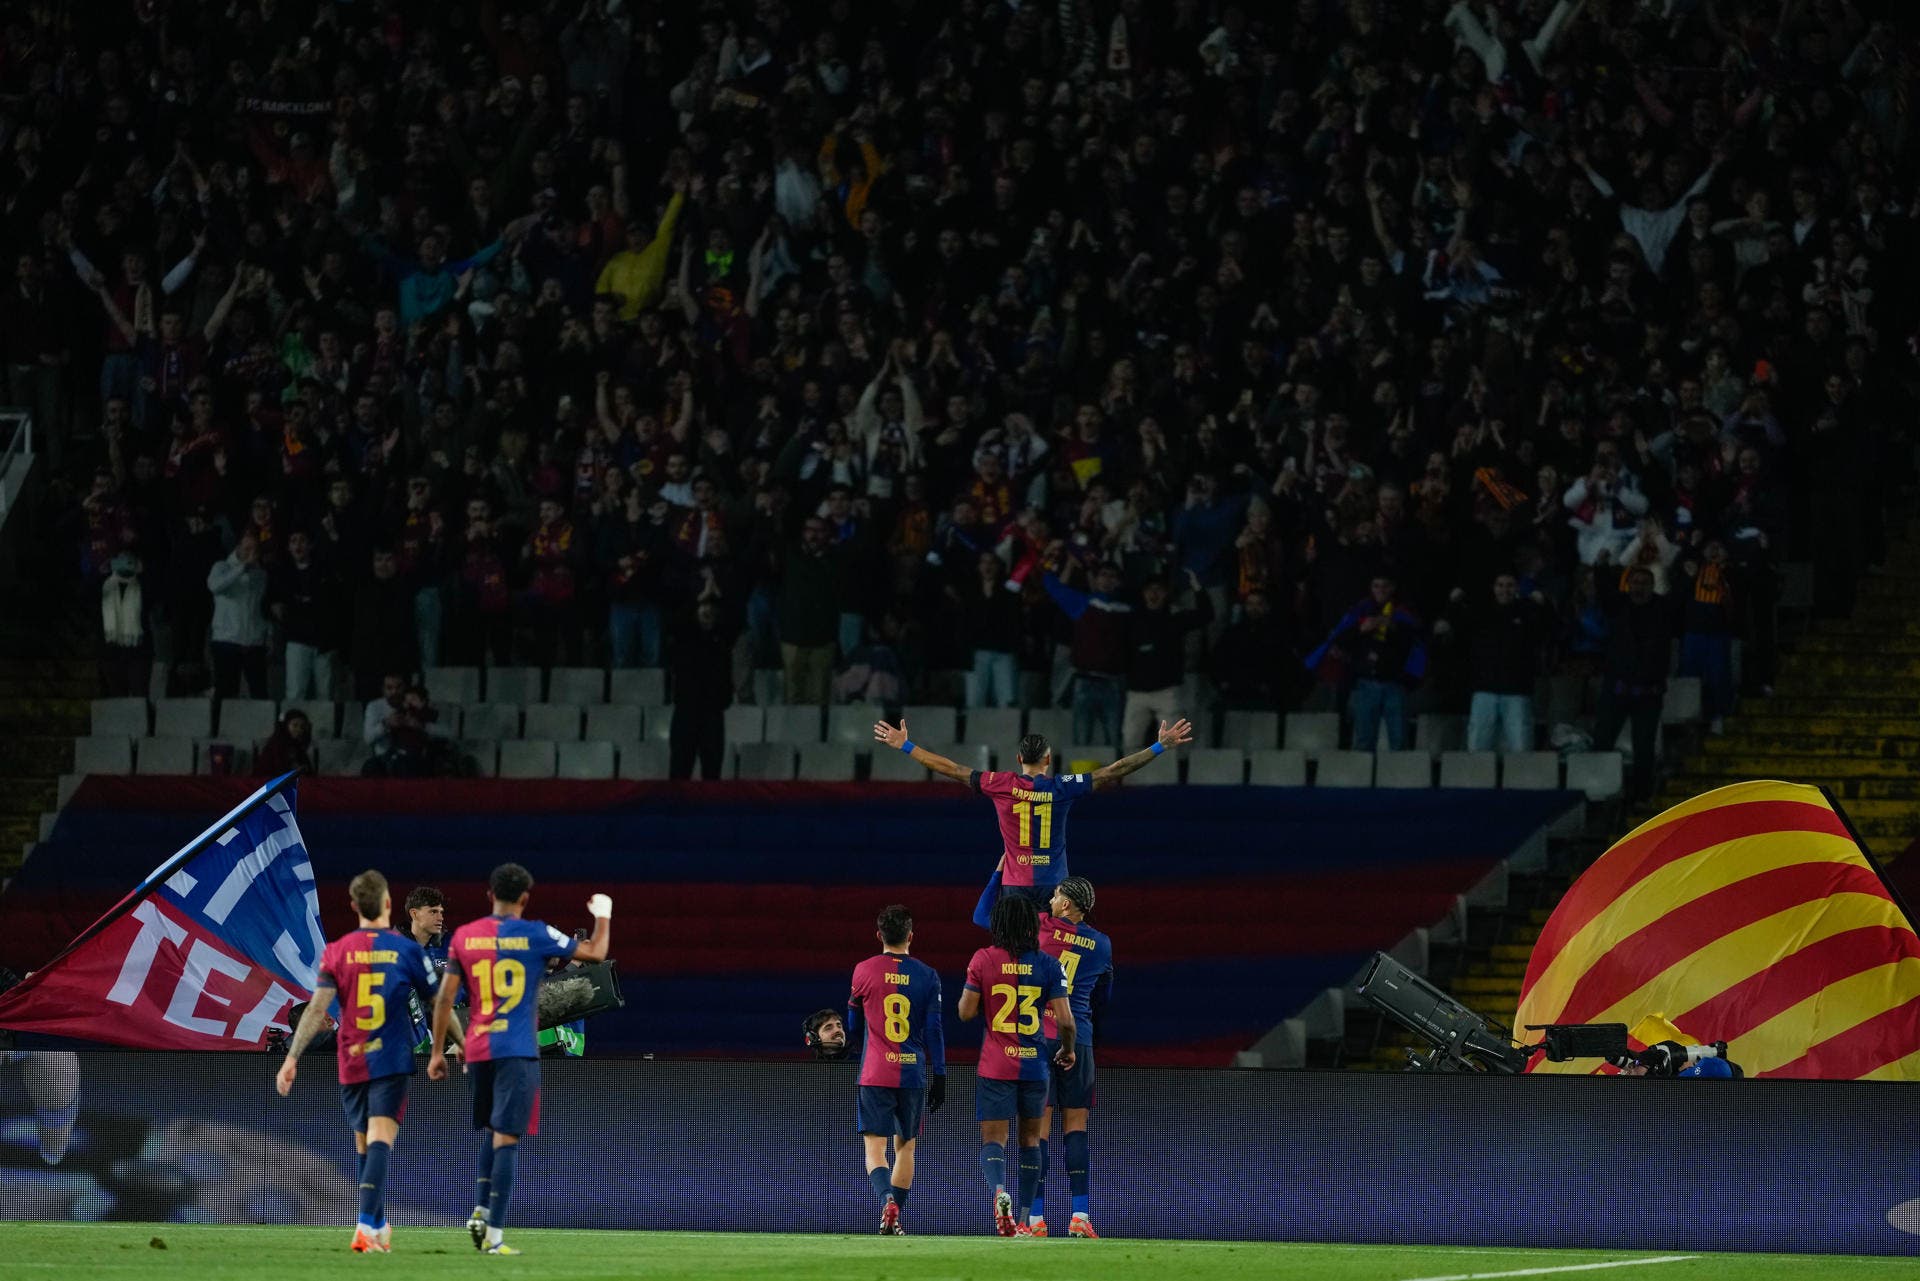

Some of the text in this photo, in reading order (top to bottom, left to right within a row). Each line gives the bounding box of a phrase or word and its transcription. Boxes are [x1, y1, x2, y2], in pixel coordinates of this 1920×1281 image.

[1011, 787, 1053, 802] RAPHINHA
[1012, 801, 1052, 848] 11
[1053, 929, 1096, 950] R. ARAUJO
[355, 972, 386, 1031] 5
[471, 958, 526, 1015] 19
[884, 972, 910, 985] PEDRI
[883, 993, 911, 1043] 8
[991, 983, 1042, 1035] 23
